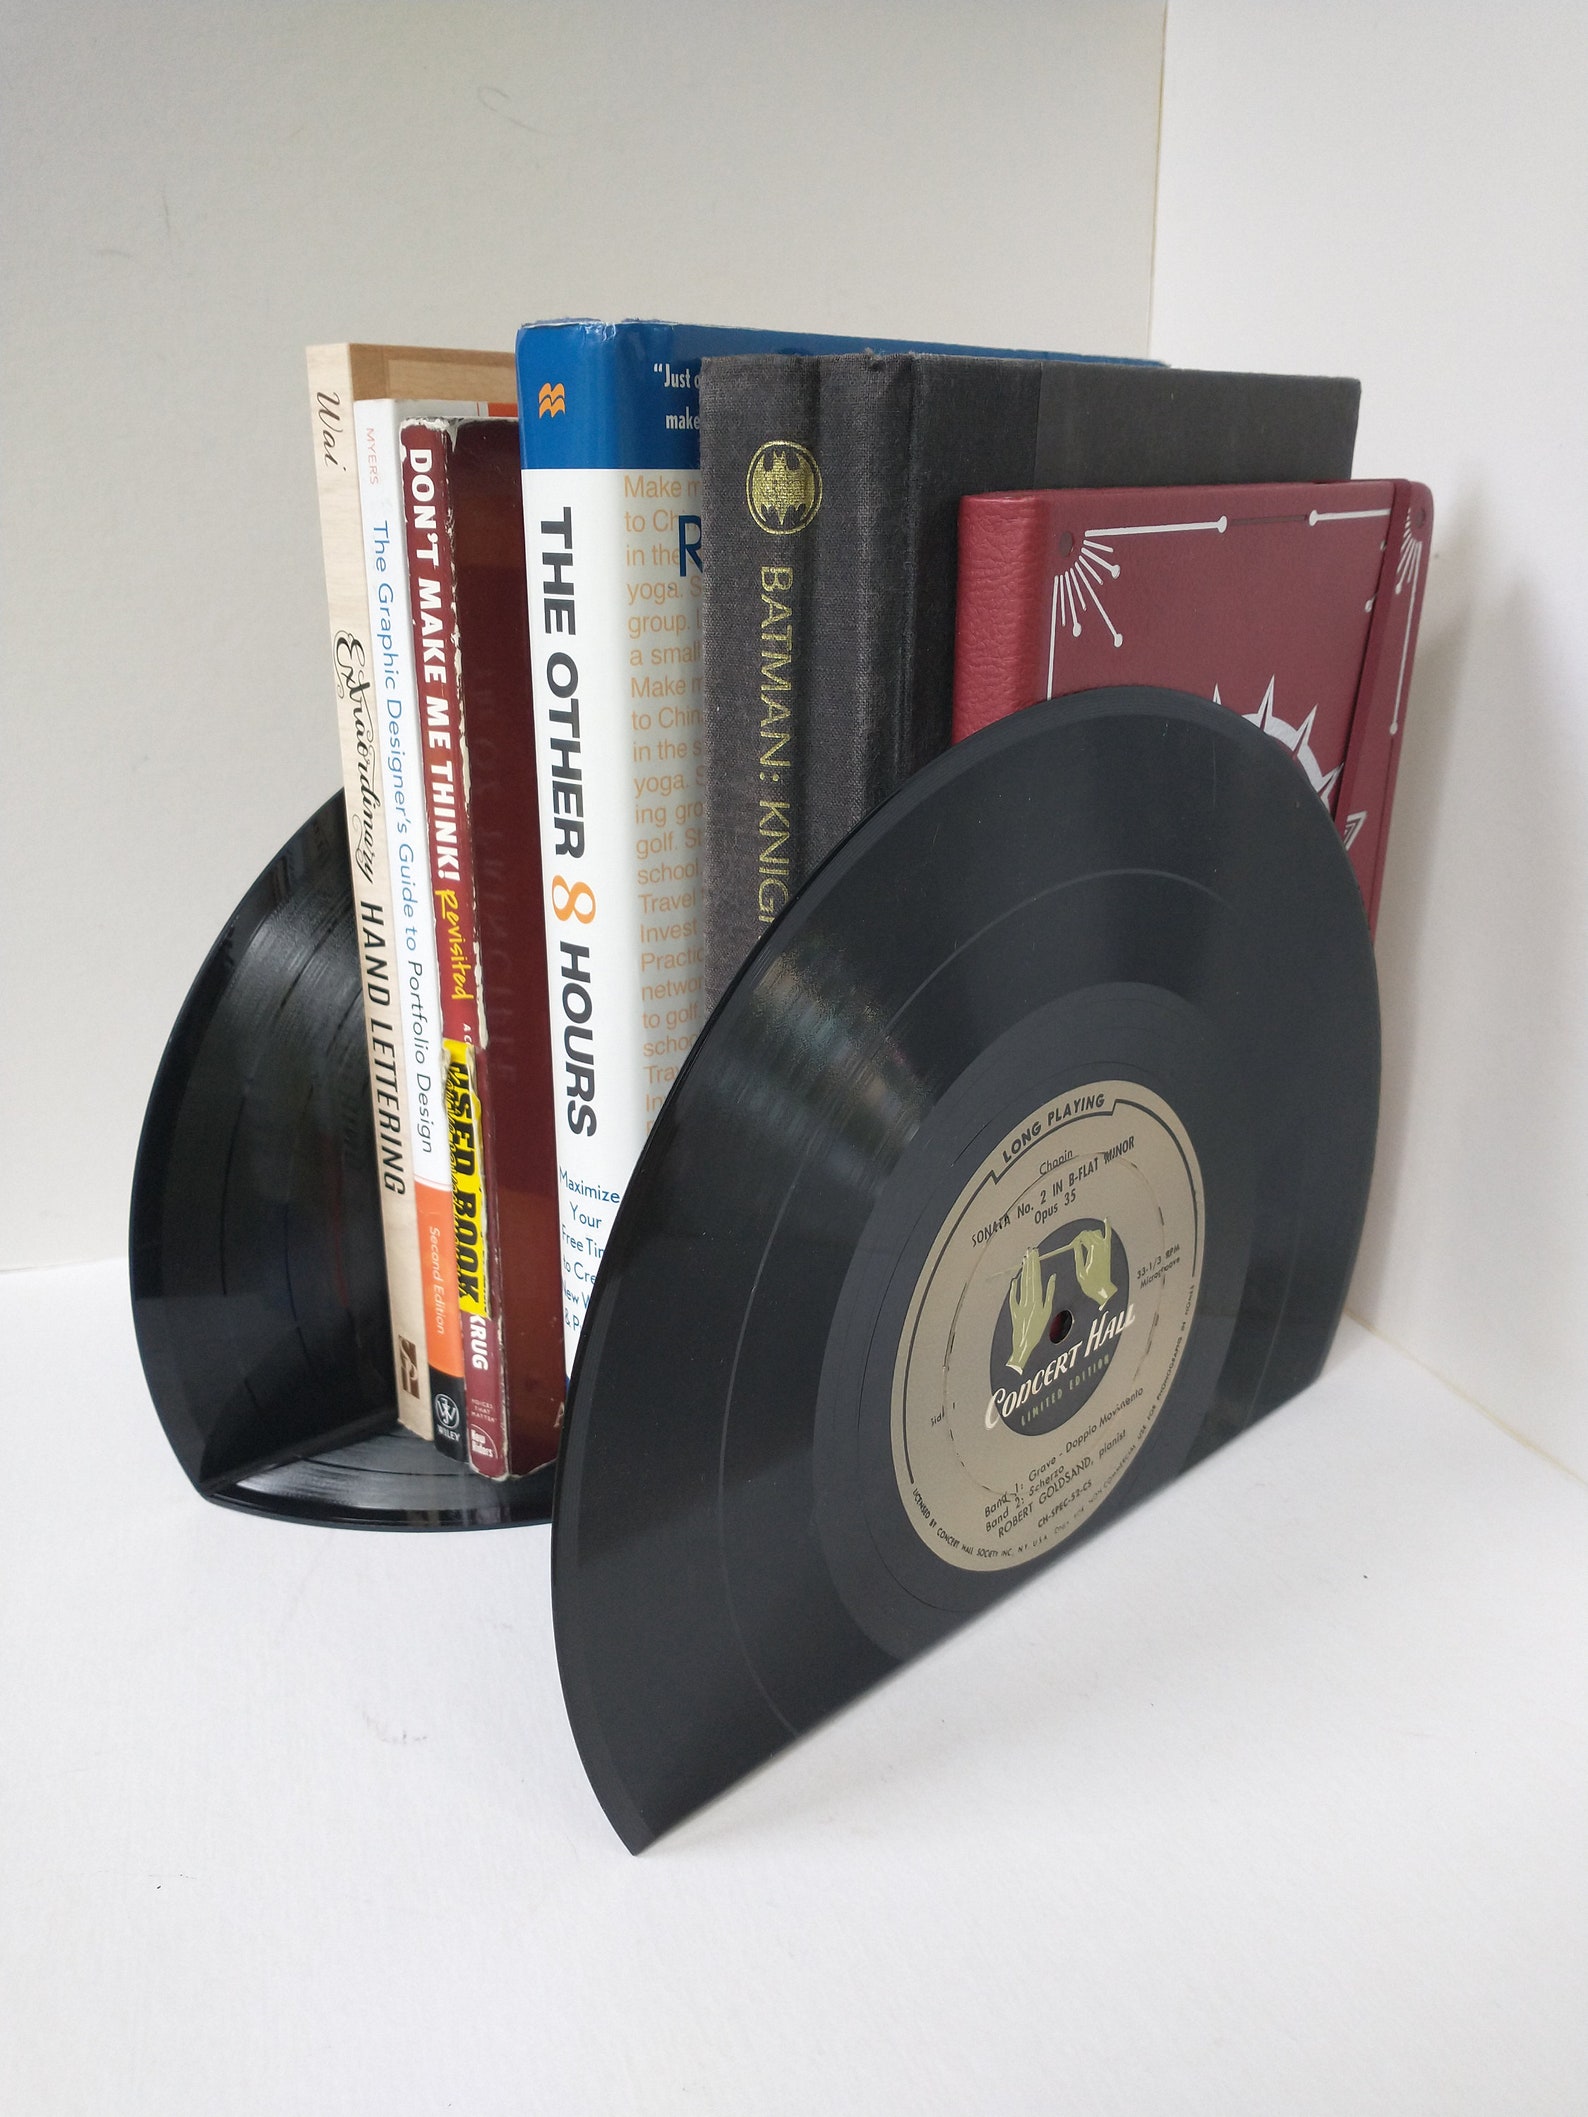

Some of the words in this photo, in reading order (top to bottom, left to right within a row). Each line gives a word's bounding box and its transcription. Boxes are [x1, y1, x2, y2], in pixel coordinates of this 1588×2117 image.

[366, 427, 379, 485] MYERS
[409, 449, 440, 570] DON'T
[624, 474, 682, 498] Make
[373, 520, 391, 573] The
[624, 511, 646, 533] to
[541, 506, 576, 636] THE
[626, 544, 645, 567] in
[627, 581, 684, 606] yoga.
[376, 582, 400, 690] Graphic
[418, 577, 447, 684] MAKE
[628, 613, 691, 640] group.
[629, 648, 643, 667] a
[759, 566, 794, 782] BATMAN:
[630, 675, 687, 699] Make
[425, 695, 452, 751] ME
[631, 711, 652, 731] to
[333, 629, 381, 884] Extraordinary
[386, 699, 412, 834] Designer's
[546, 651, 586, 859] OTHER
[632, 741, 651, 763] in
[656, 739, 688, 760] the
[430, 760, 461, 882] THINK!
[634, 803, 667, 828] ing
[398, 842, 418, 919] Guide
[757, 800, 791, 924] KNIG
[551, 874, 597, 925] 8
[638, 887, 697, 915] Travel
[360, 900, 391, 1007] HAND
[404, 926, 418, 952] to
[639, 918, 698, 945] Invest
[407, 960, 430, 1065] Portfolio
[559, 939, 598, 1138] HOURS
[642, 1011, 661, 1030] to
[370, 1017, 406, 1196] LETTERING
[416, 1072, 435, 1154] Design
[449, 1062, 476, 1177] USED
[1002, 1120, 1042, 1164] LONG
[1047, 1093, 1105, 1127] PLAYING
[559, 1165, 621, 1204] Maximize
[970, 1212, 1012, 1248] SONATA
[1016, 1203, 1034, 1219] No.
[1040, 1189, 1047, 1206] 2
[1052, 1179, 1063, 1197] IN
[1068, 1157, 1099, 1187] B-FLAT
[1103, 1135, 1135, 1165] MINOR
[1039, 1149, 1074, 1176] Chopin
[569, 1200, 603, 1229] Your
[1034, 1203, 1059, 1225] Opus
[1064, 1188, 1077, 1207] 35
[429, 1226, 445, 1283] Second
[452, 1190, 480, 1304] BOOK
[432, 1284, 449, 1335] Edition
[469, 1314, 489, 1372] KRUG
[984, 1340, 1084, 1431] CONCERT
[1020, 1388, 1063, 1427] LIMITED
[1069, 1353, 1110, 1390] EDITION
[437, 1425, 461, 1443] WILEY
[984, 1491, 1009, 1518] Band
[1028, 1456, 1057, 1482] Grave
[1065, 1423, 1098, 1454] Doppio
[985, 1506, 1009, 1533] Band
[1015, 1497, 1025, 1509] 2:
[1028, 1465, 1065, 1497] Scherzo
[998, 1501, 1034, 1539] ROBERT
[1038, 1456, 1094, 1506] GOLDSAND,
[1098, 1428, 1127, 1460] pianist
[912, 1487, 931, 1519] LICENSED
[928, 1518, 938, 1529] BY
[936, 1527, 961, 1549] CONCERT
[1037, 1479, 1093, 1529] CH-SPEC-52-CS
